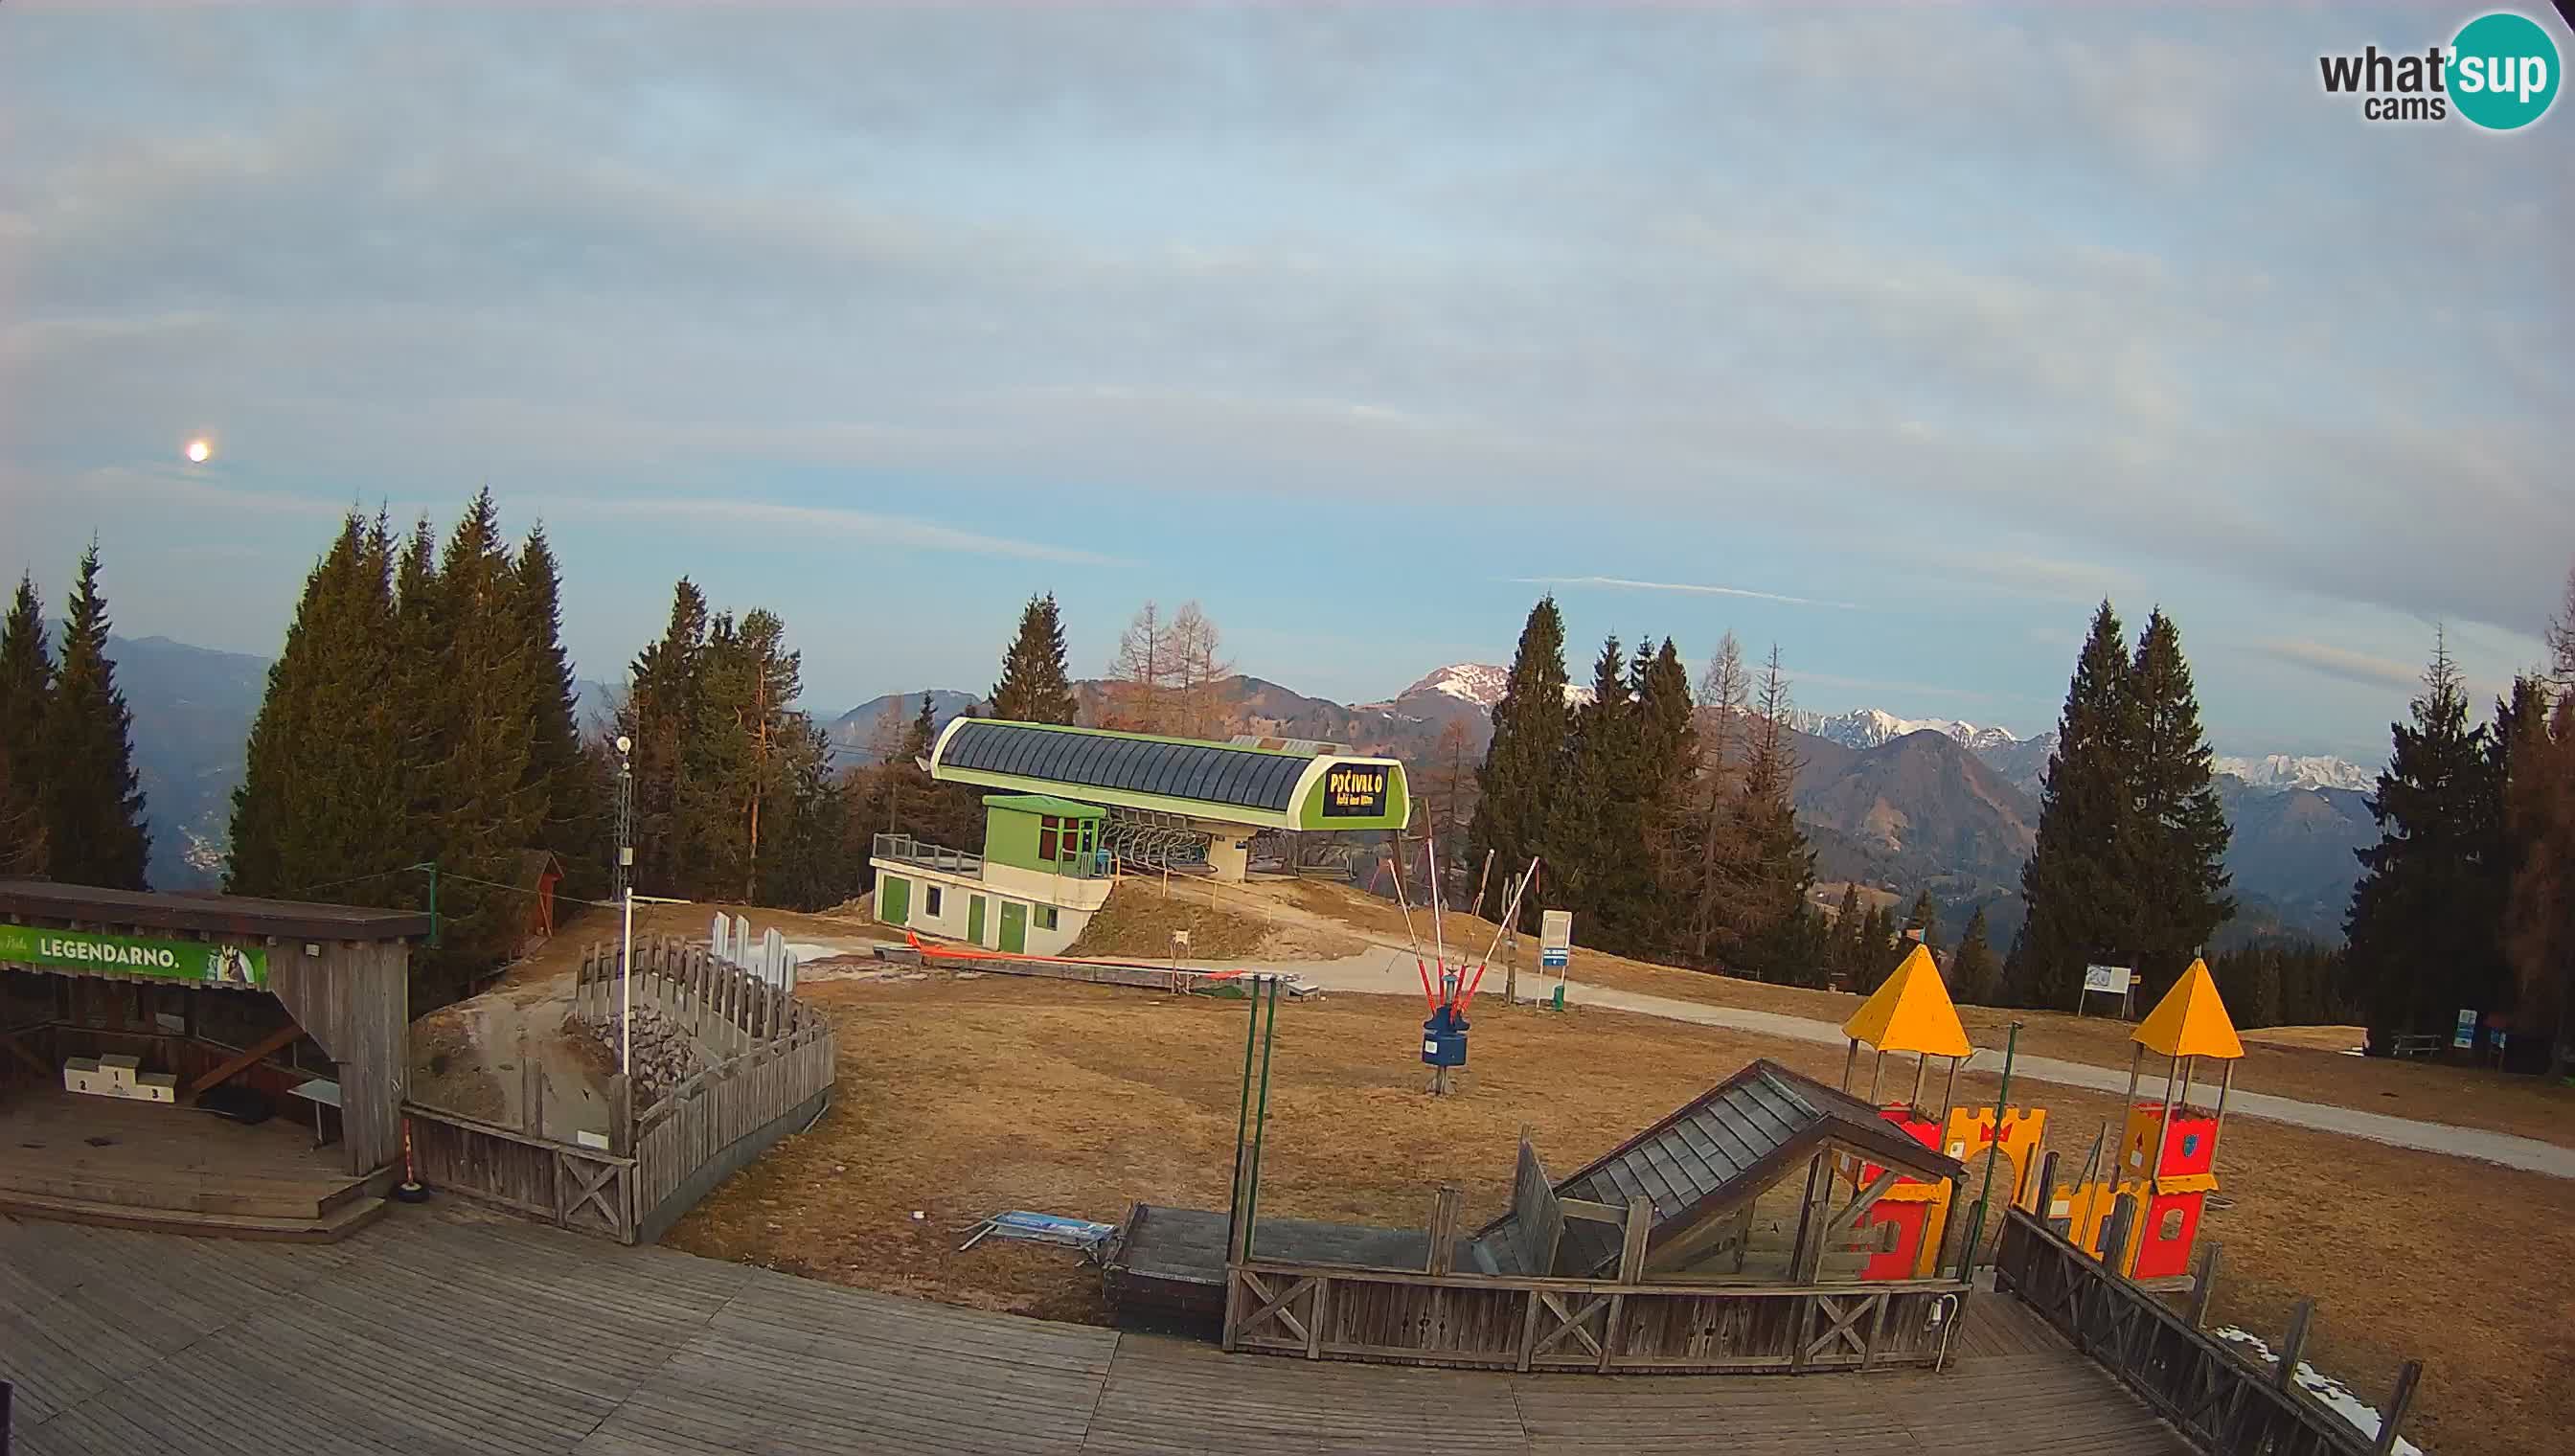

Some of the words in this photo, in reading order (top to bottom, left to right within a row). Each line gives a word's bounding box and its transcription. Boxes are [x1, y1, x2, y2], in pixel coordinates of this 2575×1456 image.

[39, 937, 180, 969] LEGENDARNO.
[113, 1070, 120, 1081] 1
[79, 1080, 87, 1091] 2
[151, 1088, 159, 1099] 3
